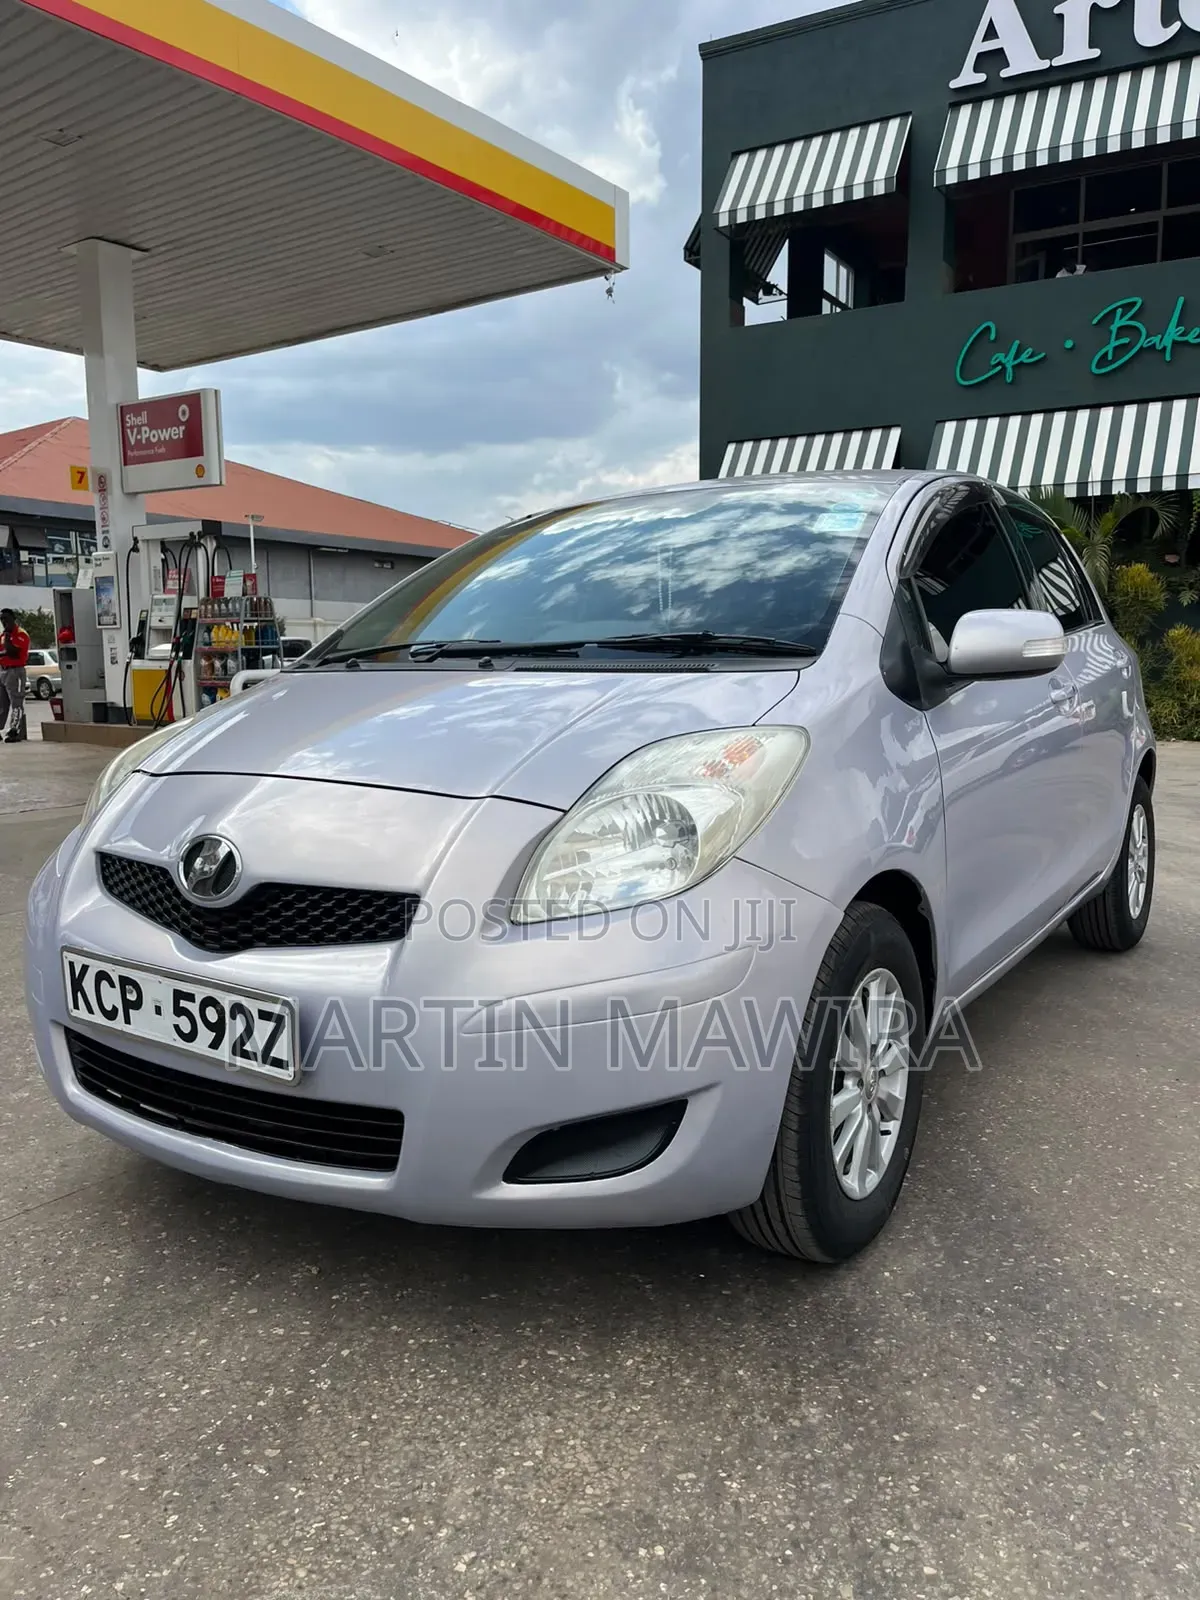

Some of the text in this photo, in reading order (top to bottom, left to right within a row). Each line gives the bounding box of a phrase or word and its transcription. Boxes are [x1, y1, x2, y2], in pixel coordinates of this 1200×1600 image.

[955, 321, 1046, 386] Cafe
[126, 410, 148, 427] Shell
[127, 425, 186, 446] V-Power
[76, 470, 85, 484] 7
[68, 960, 143, 1026] KCP
